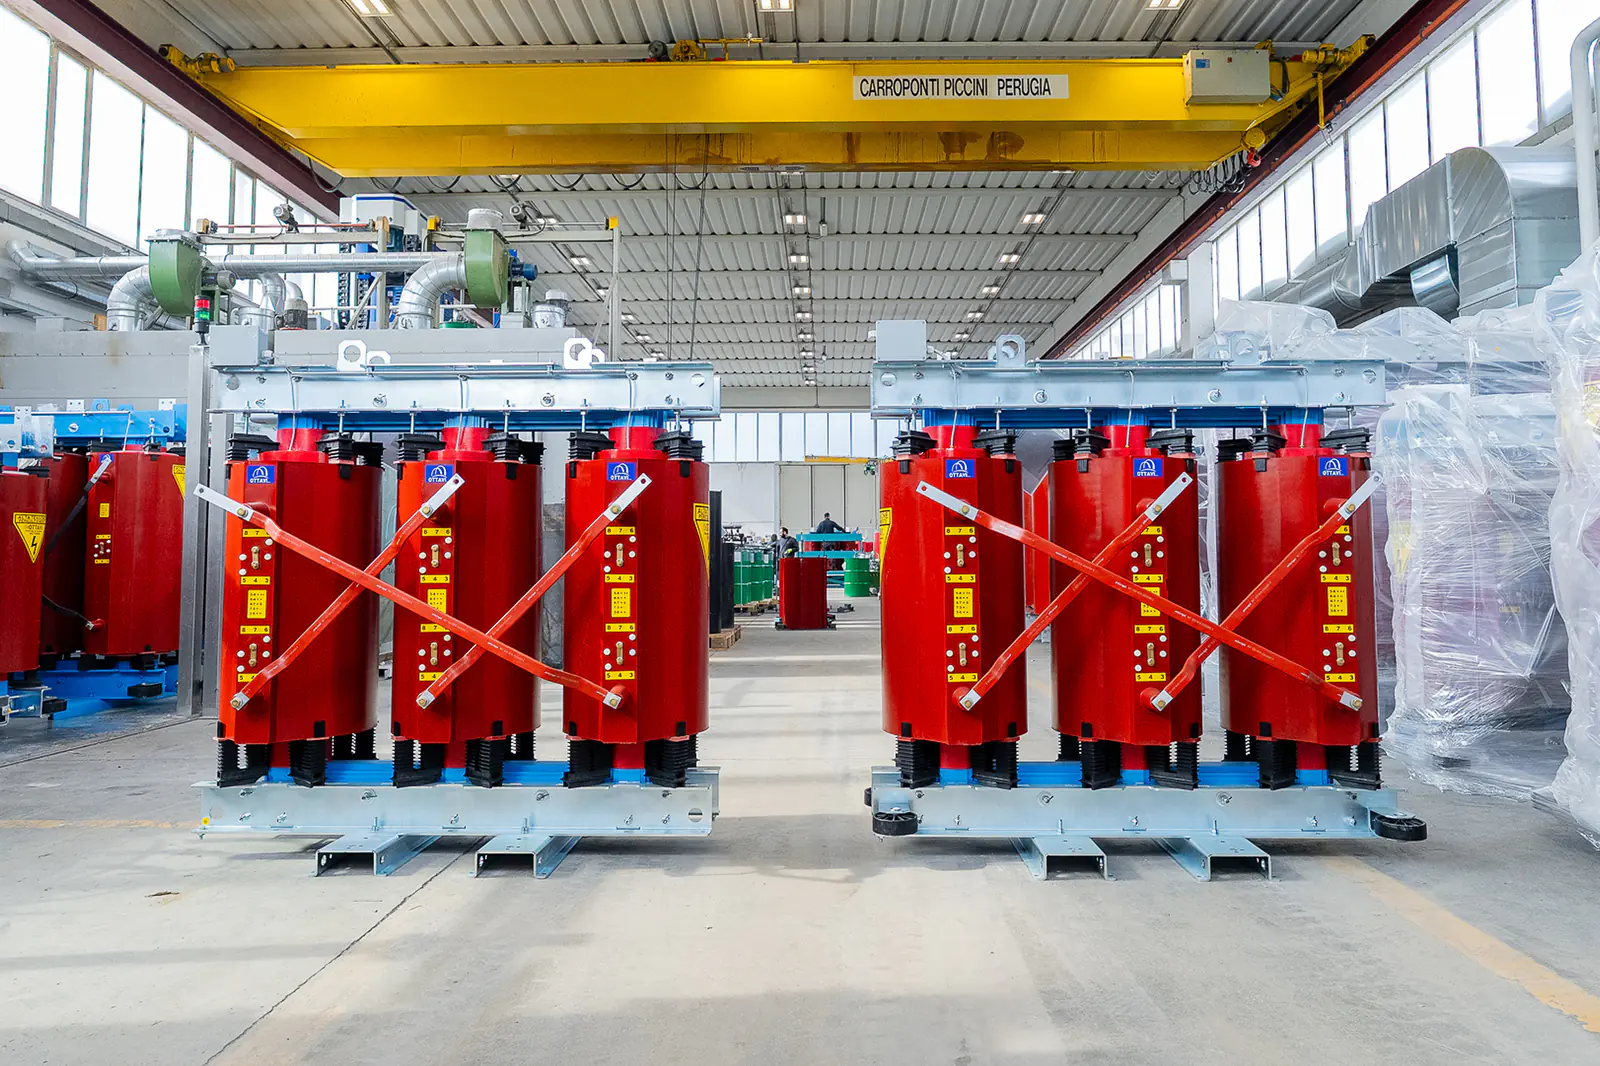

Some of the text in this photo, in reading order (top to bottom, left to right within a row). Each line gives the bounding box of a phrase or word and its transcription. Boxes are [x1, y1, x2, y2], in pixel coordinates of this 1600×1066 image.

[860, 78, 1052, 97] CARROPONTI PICCINI PERUGIA
